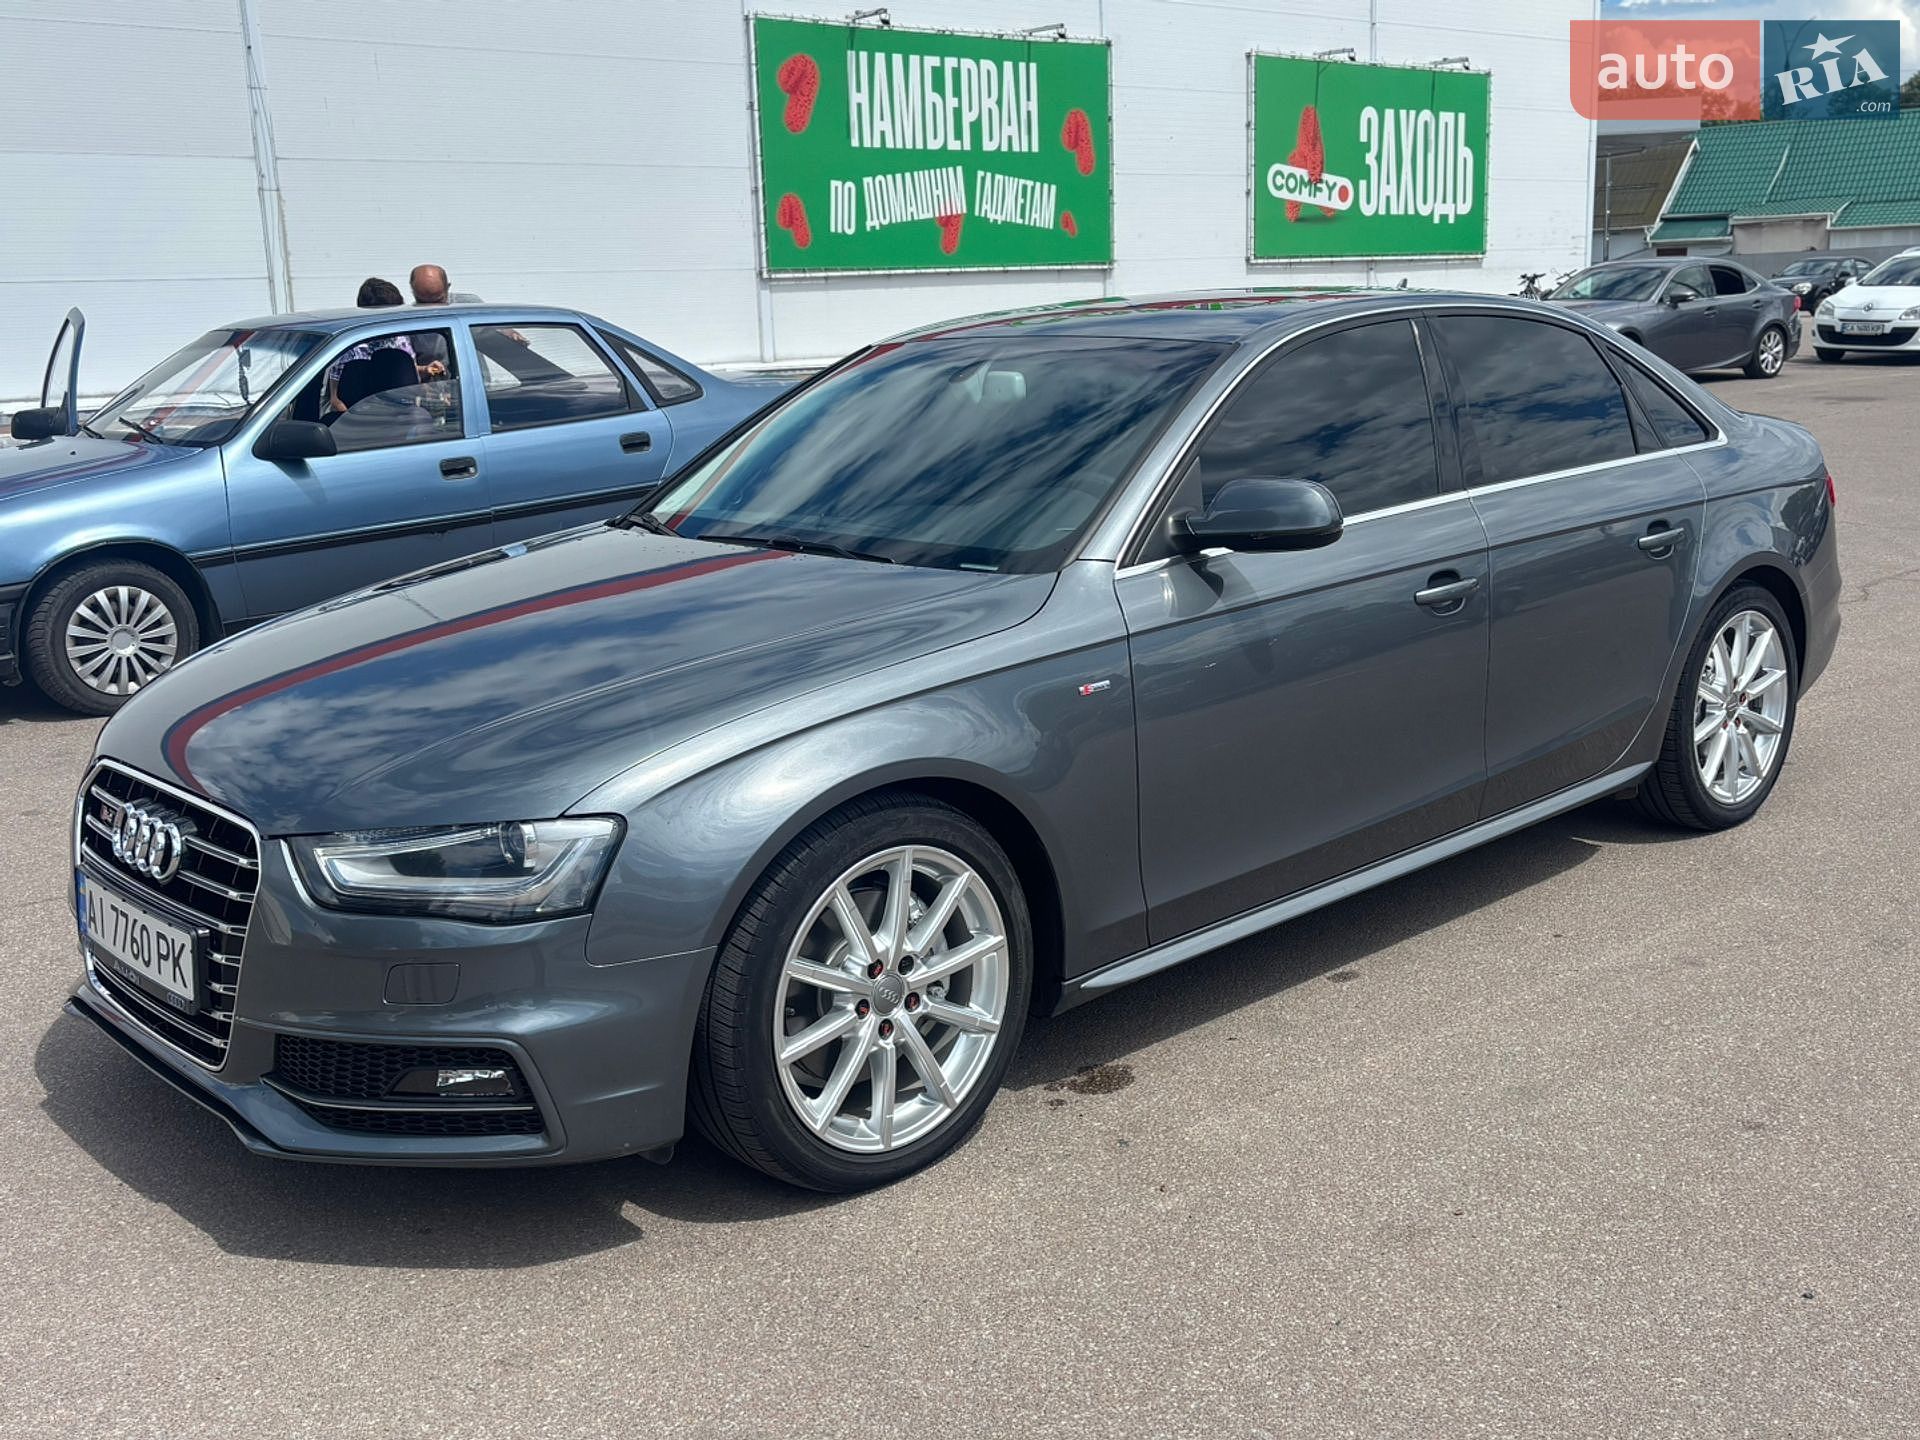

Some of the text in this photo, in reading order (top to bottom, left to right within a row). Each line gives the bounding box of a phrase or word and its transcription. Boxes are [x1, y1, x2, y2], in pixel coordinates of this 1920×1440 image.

[847, 50, 1039, 153] НАМБЕРВАН
[830, 166, 1057, 235] ПО ДОМАШНІМ ГАДЖЕТАМ
[1272, 169, 1337, 201] COMFY
[1358, 106, 1474, 224] ЗАХОДЬ
[88, 889, 188, 989] AI 7760 PK
